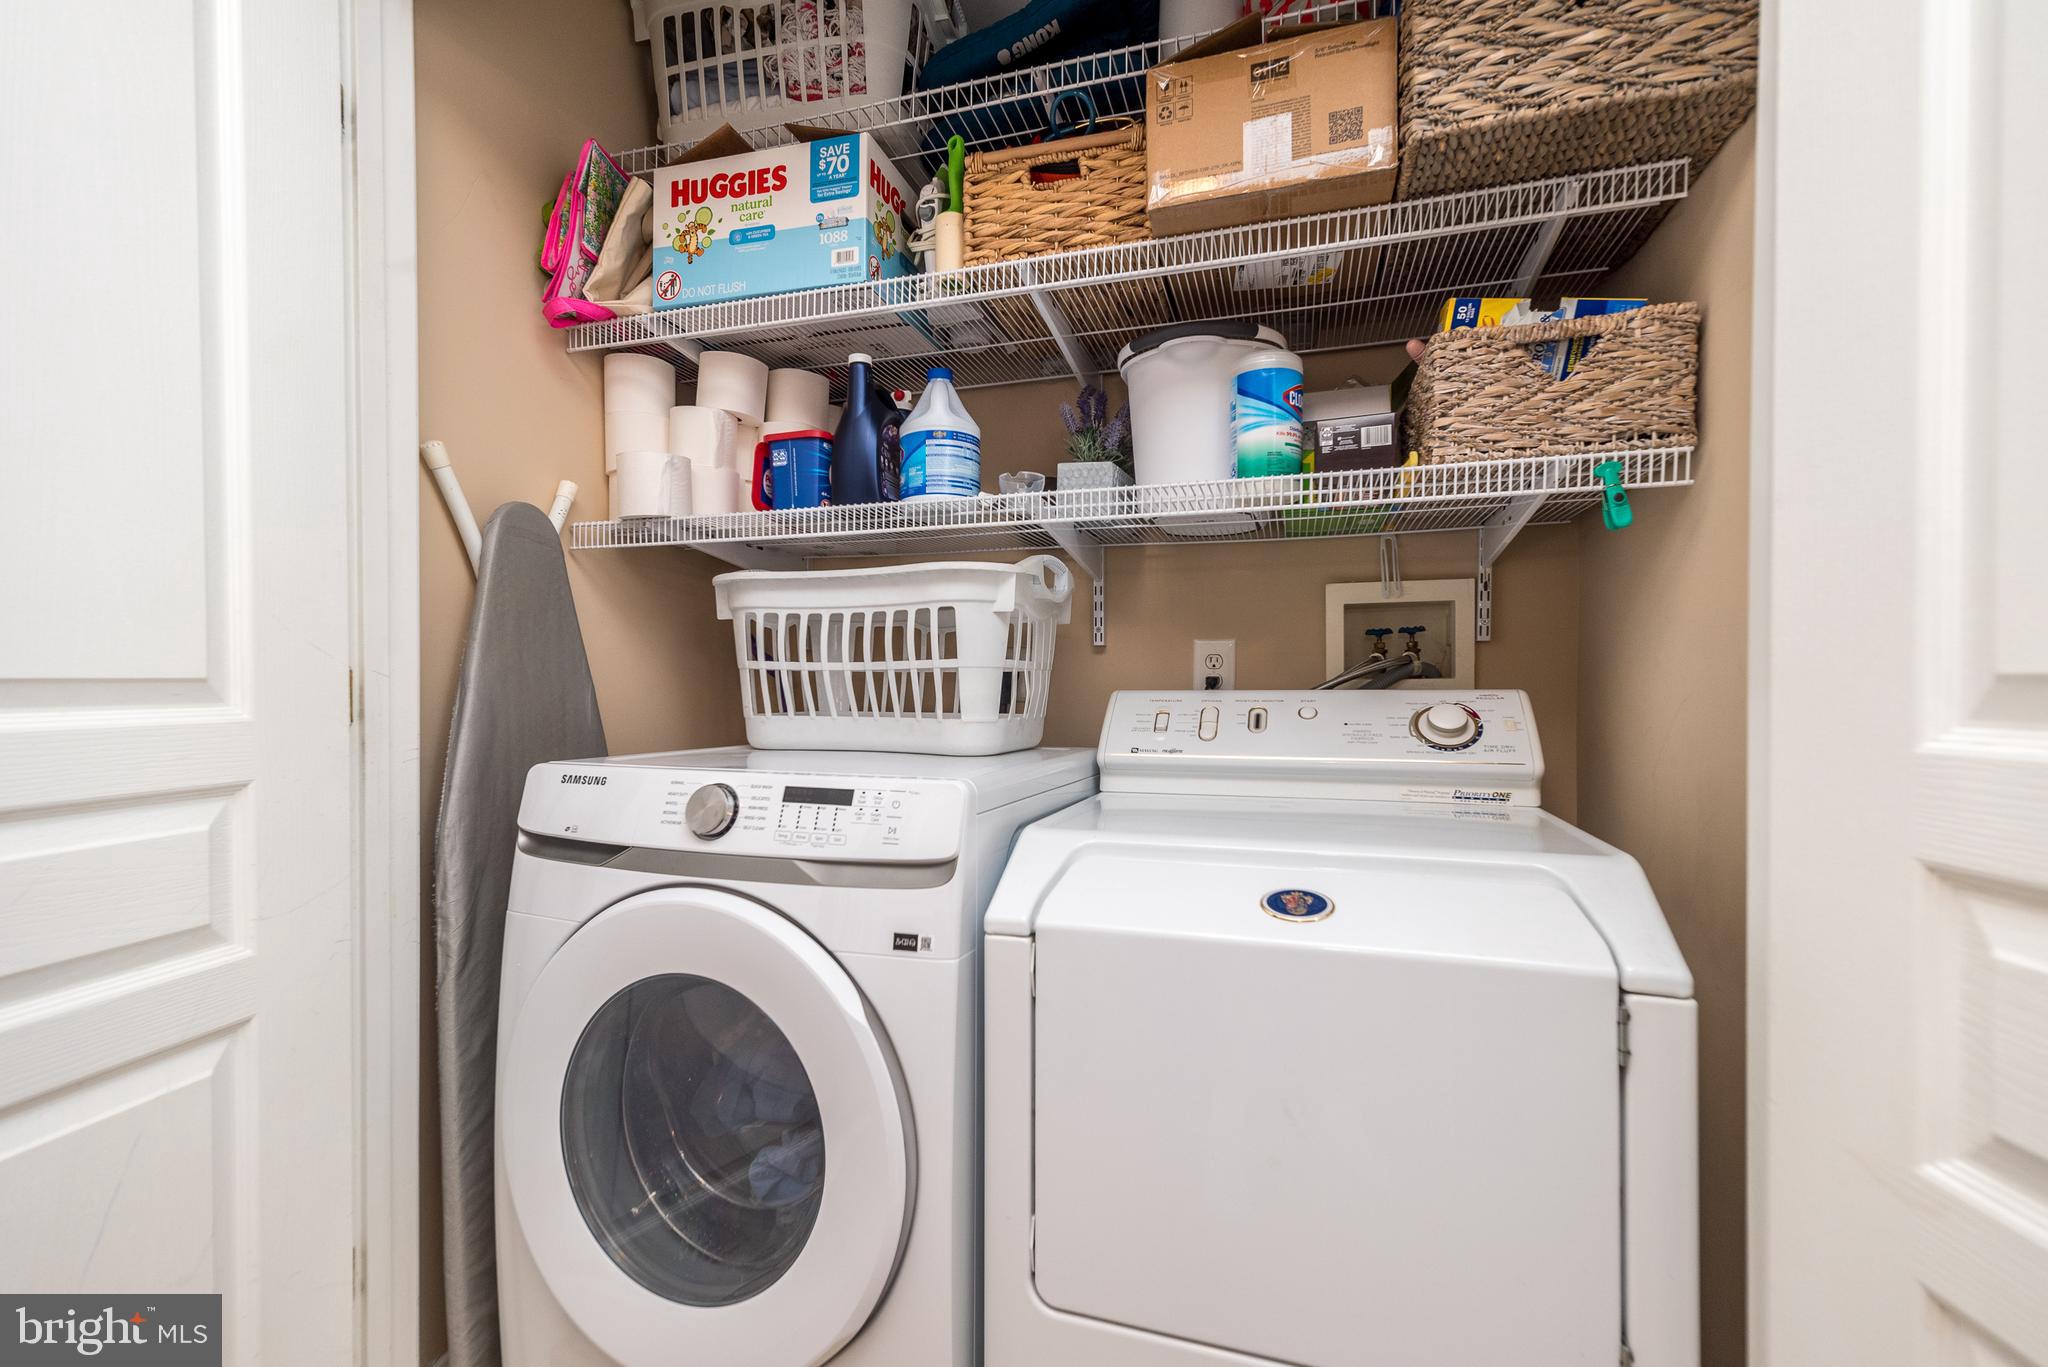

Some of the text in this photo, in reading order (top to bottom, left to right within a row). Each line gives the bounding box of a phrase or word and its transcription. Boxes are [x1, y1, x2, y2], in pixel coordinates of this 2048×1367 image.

[1011, 18, 1061, 59] KONG
[820, 143, 850, 158] SAVE
[818, 154, 850, 175] $70
[671, 165, 788, 208] HUGGIES
[730, 195, 773, 213] natural
[739, 210, 765, 223] care
[820, 230, 849, 245] 1088
[682, 281, 746, 299] DO NOT FLUSH
[1456, 306, 1468, 320] 50
[561, 774, 608, 786] SAMSUNG
